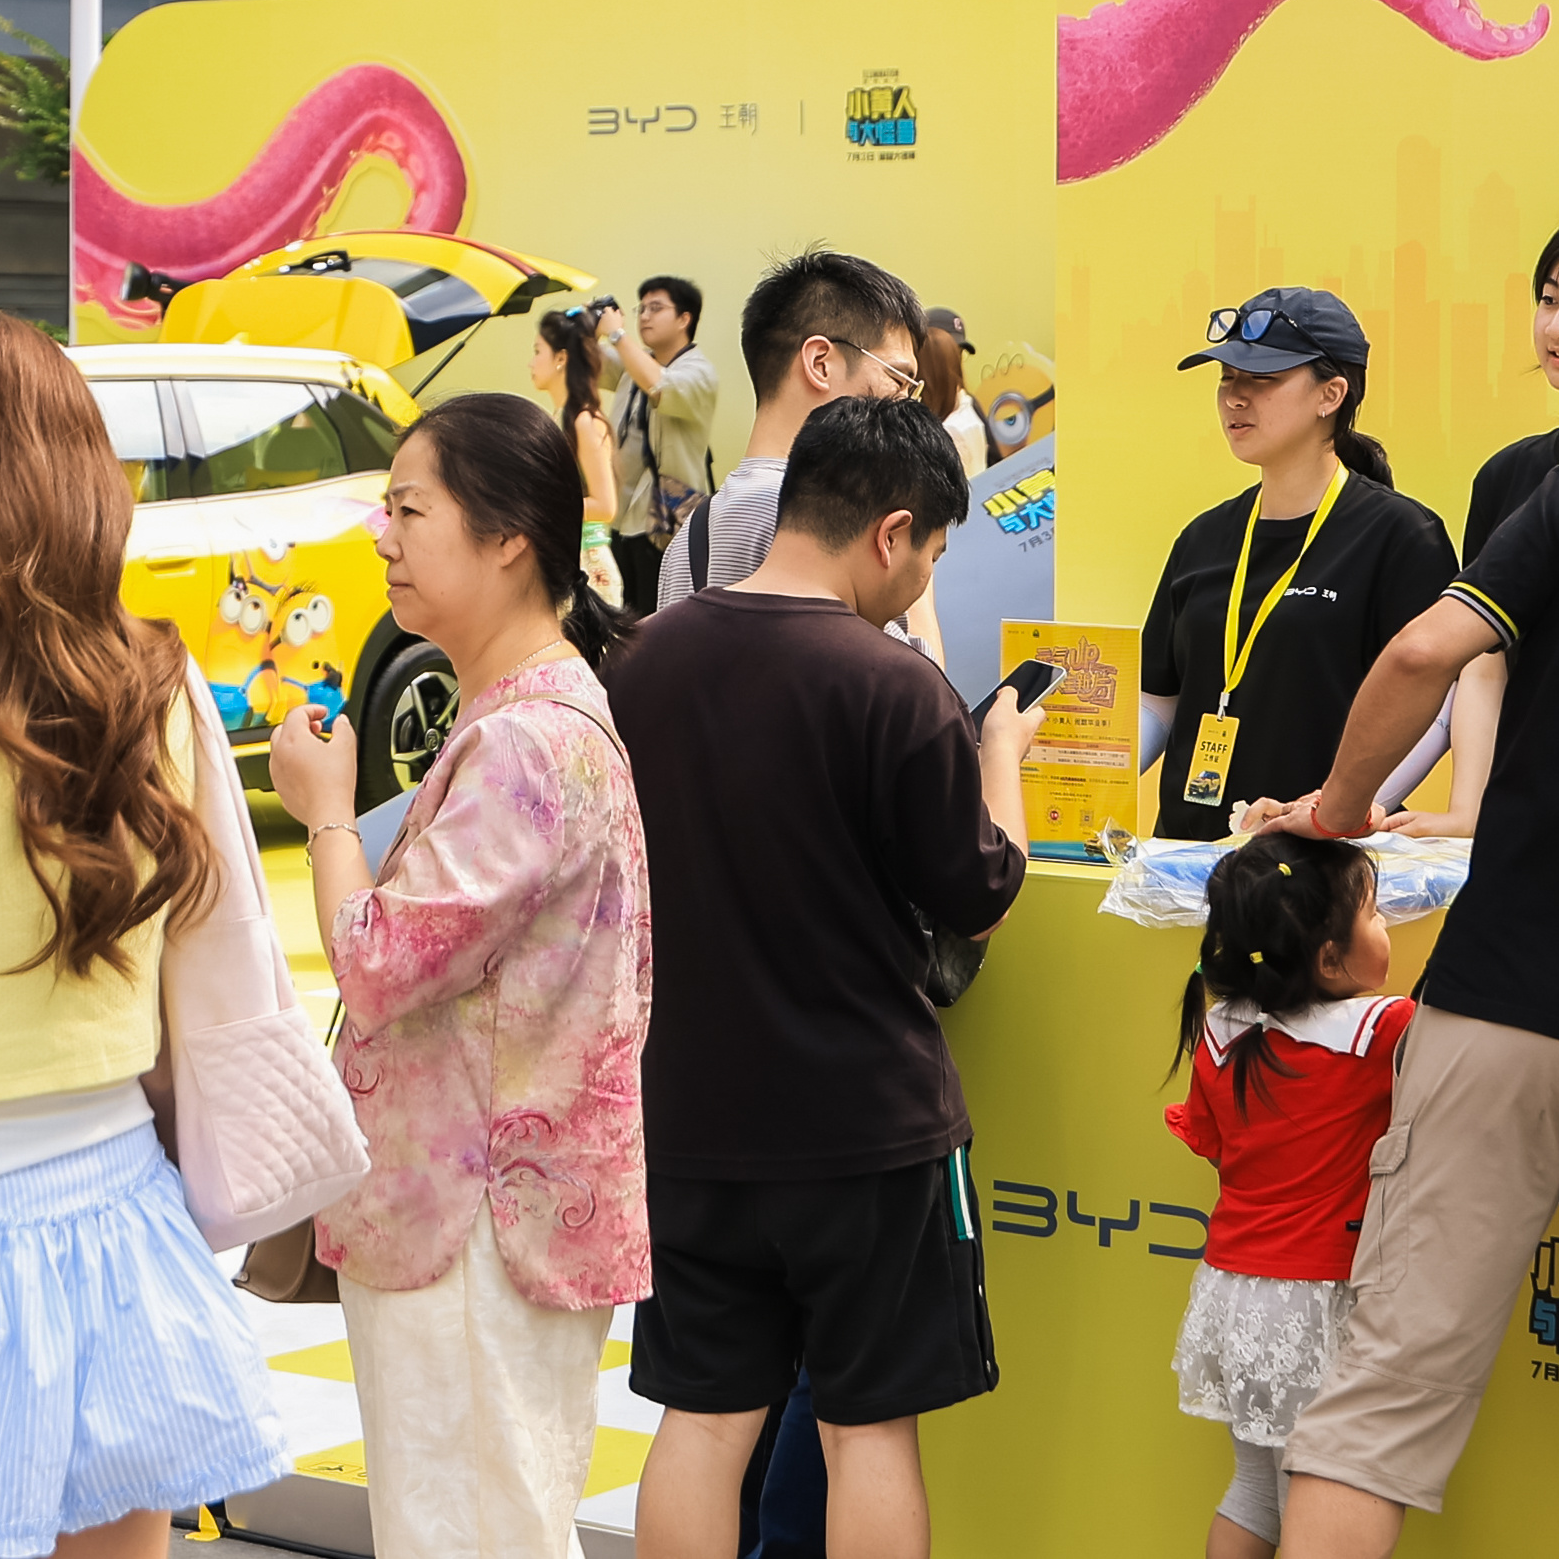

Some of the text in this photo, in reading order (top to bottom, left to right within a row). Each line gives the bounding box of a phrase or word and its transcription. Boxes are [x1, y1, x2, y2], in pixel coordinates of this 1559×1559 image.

[588, 102, 760, 136] BYD 王朝
[1200, 741, 1228, 754] STAFF
[992, 1179, 1208, 1260] BYD
